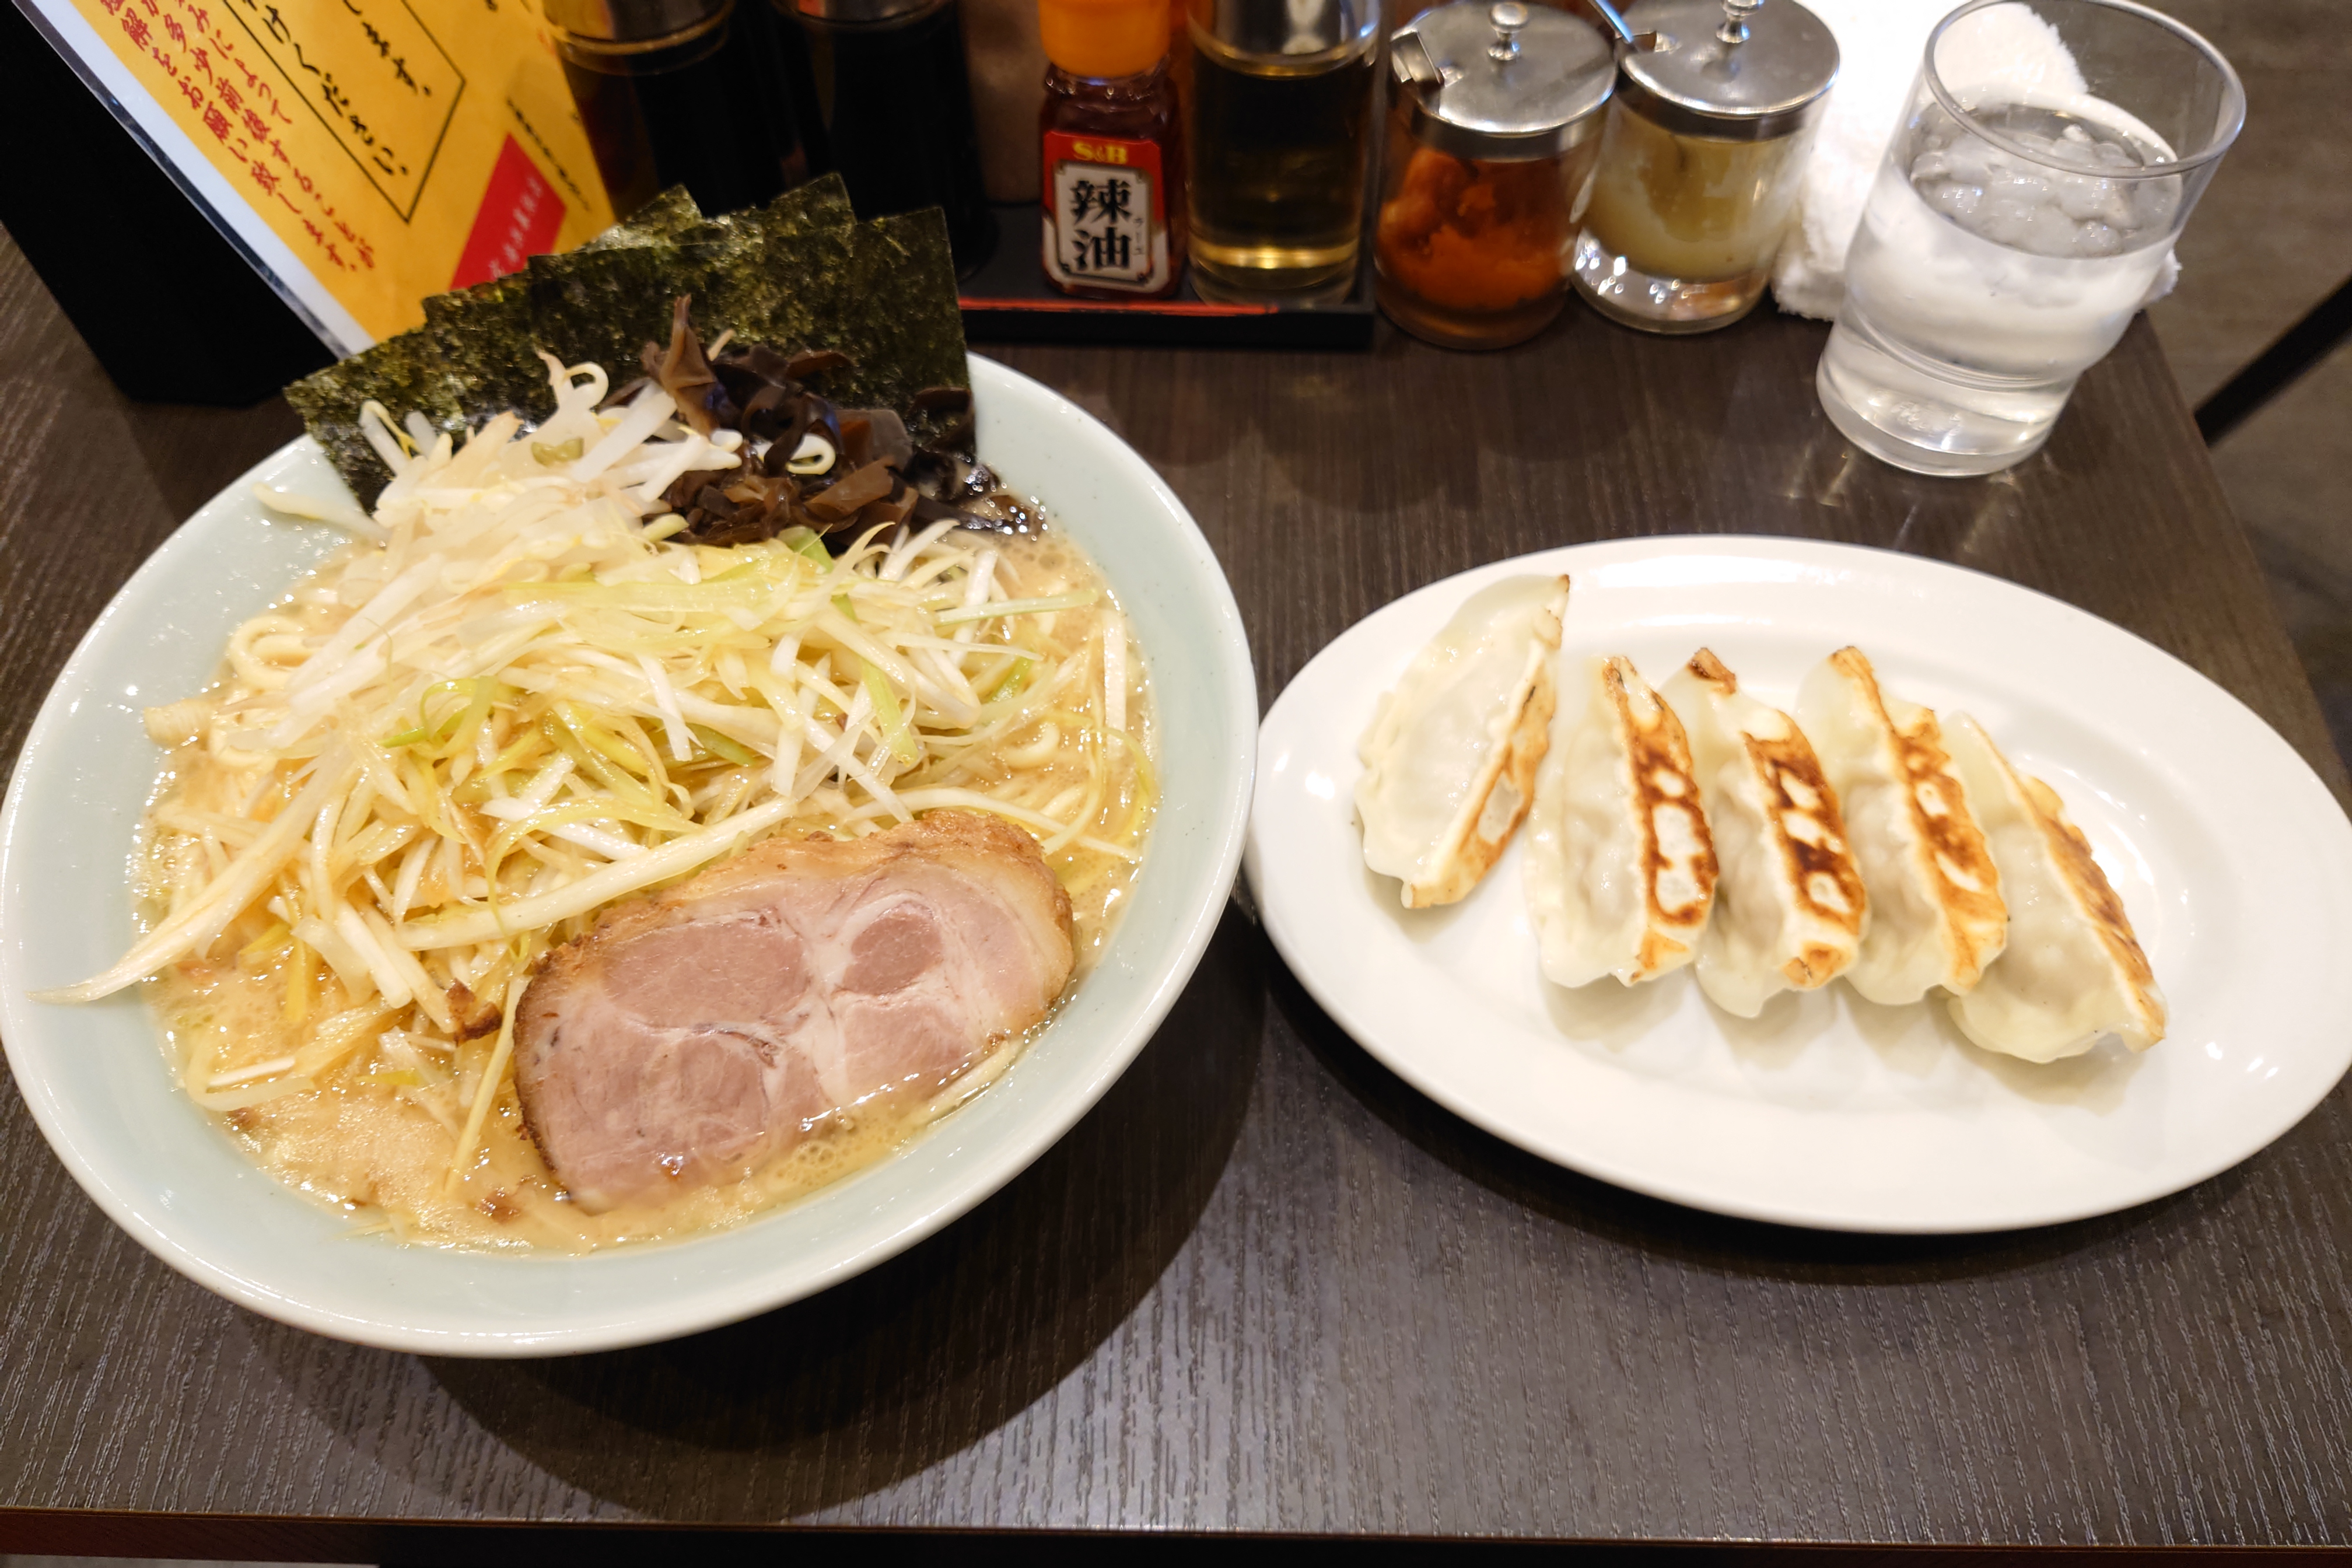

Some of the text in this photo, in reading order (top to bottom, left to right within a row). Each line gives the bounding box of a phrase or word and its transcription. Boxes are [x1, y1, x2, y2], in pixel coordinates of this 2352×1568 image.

[177, 0, 292, 124] みによって
[1072, 141, 1127, 164] S&B
[1069, 178, 1132, 271] 辣油
